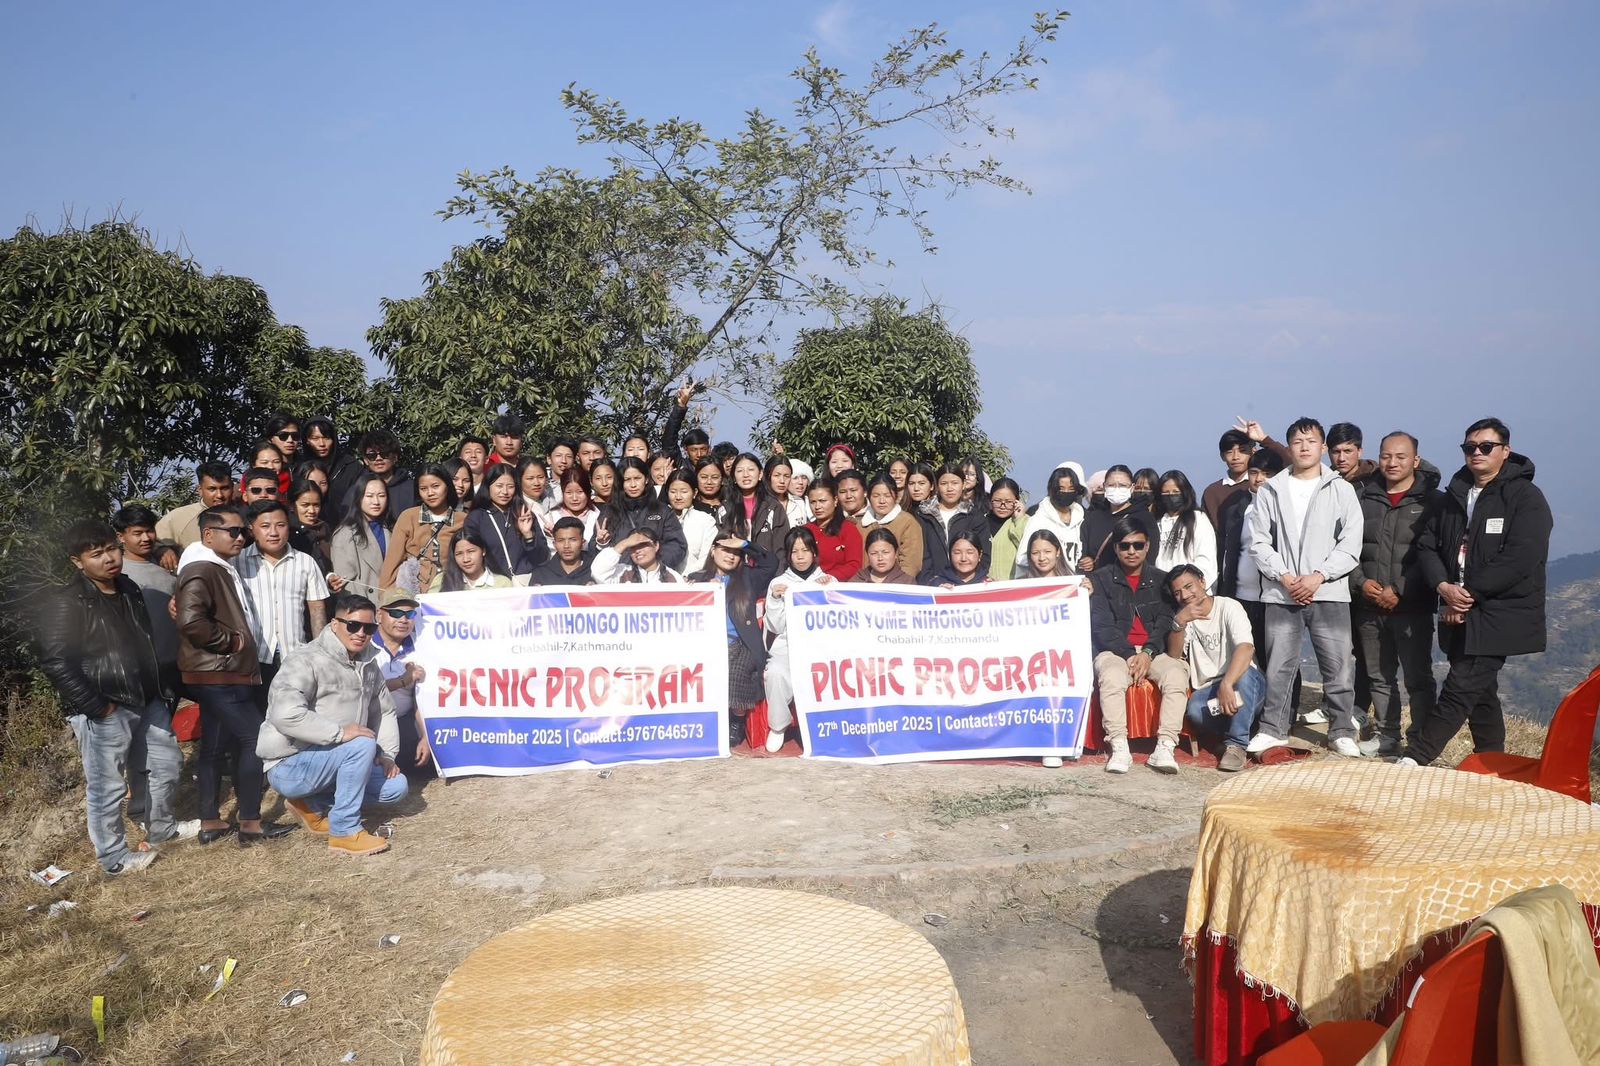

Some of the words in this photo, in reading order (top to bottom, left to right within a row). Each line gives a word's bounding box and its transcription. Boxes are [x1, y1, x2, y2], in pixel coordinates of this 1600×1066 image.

[434, 619, 492, 640] OUGON
[499, 614, 543, 639] UME
[548, 612, 619, 636] NIHONGO
[624, 611, 704, 635] INSTITUTE
[805, 609, 859, 631] OUGON
[864, 610, 908, 630] YUME
[912, 608, 984, 630] NIHONGO
[989, 603, 1070, 628] INSTITUTE
[437, 667, 537, 708] PICNIC
[811, 656, 905, 702] PICNIC
[913, 648, 1076, 699] PROGRAM
[434, 727, 458, 745] 27th
[462, 727, 529, 745] December
[532, 728, 562, 745] 2025
[573, 723, 704, 745] Contact:9767646573
[817, 720, 838, 738] 27th
[841, 718, 899, 736] December
[902, 715, 933, 731] 2025
[945, 708, 1074, 731] Contact:9767646573
